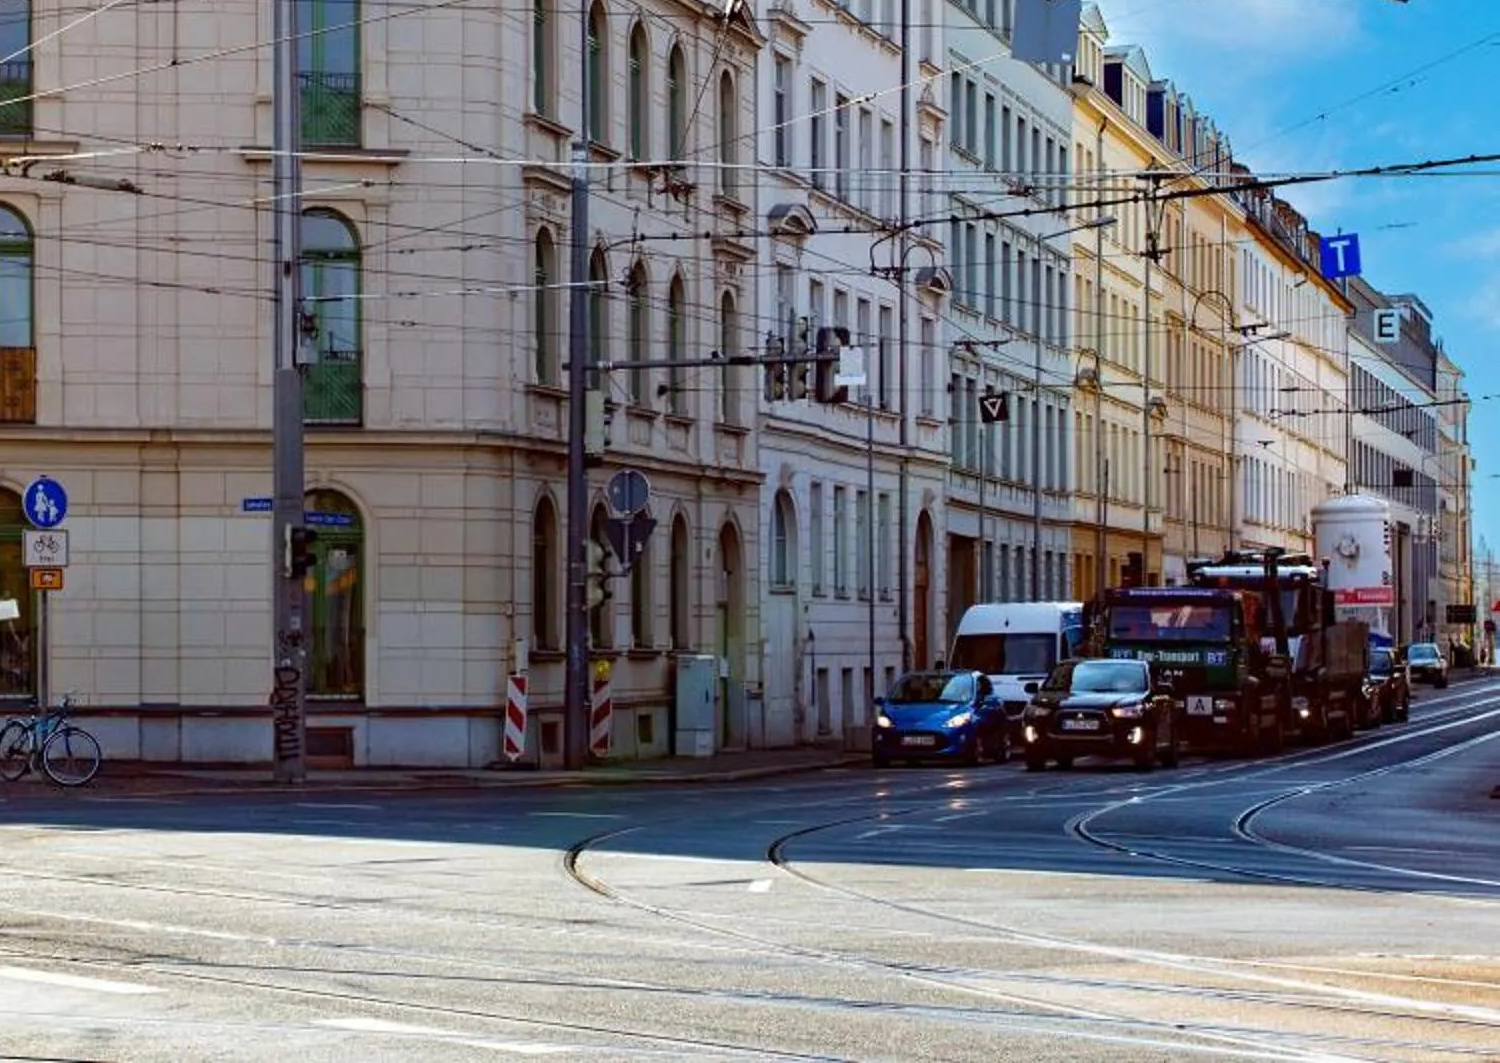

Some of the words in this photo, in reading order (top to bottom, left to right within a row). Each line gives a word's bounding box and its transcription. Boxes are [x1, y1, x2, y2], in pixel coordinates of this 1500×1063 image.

[1329, 240, 1351, 272] T
[1379, 313, 1394, 337] E
[1195, 698, 1205, 712] A
